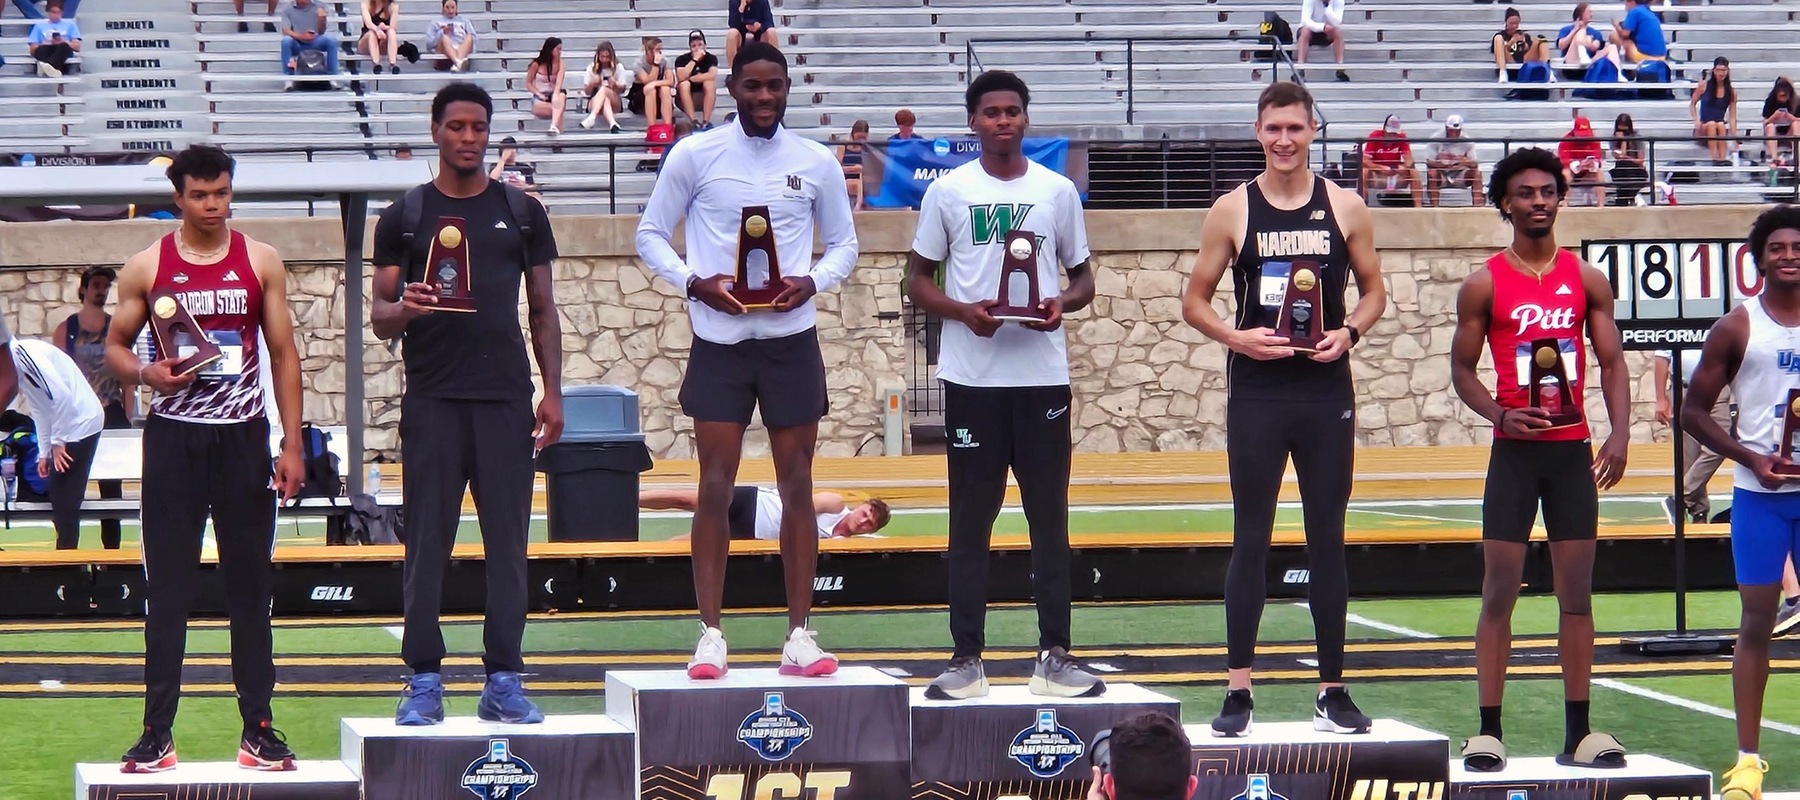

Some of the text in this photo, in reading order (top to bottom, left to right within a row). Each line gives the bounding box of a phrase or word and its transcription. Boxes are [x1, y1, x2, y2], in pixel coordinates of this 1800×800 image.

[956, 142, 980, 153] DIVI
[41, 156, 87, 166] DIVISION
[913, 168, 952, 180] MAK
[1256, 230, 1331, 257] HARDING
[175, 289, 248, 316] ADRON STATE
[1510, 303, 1576, 336] Pitt
[1623, 330, 1711, 343] PERFORMA
[813, 576, 843, 591] ILL
[310, 585, 354, 601] GILL
[739, 727, 811, 739] CHAMPIONSHIPS
[1011, 744, 1083, 755] CHAMPIONSHIPS
[464, 774, 536, 785] CHAMPIONSHIPS
